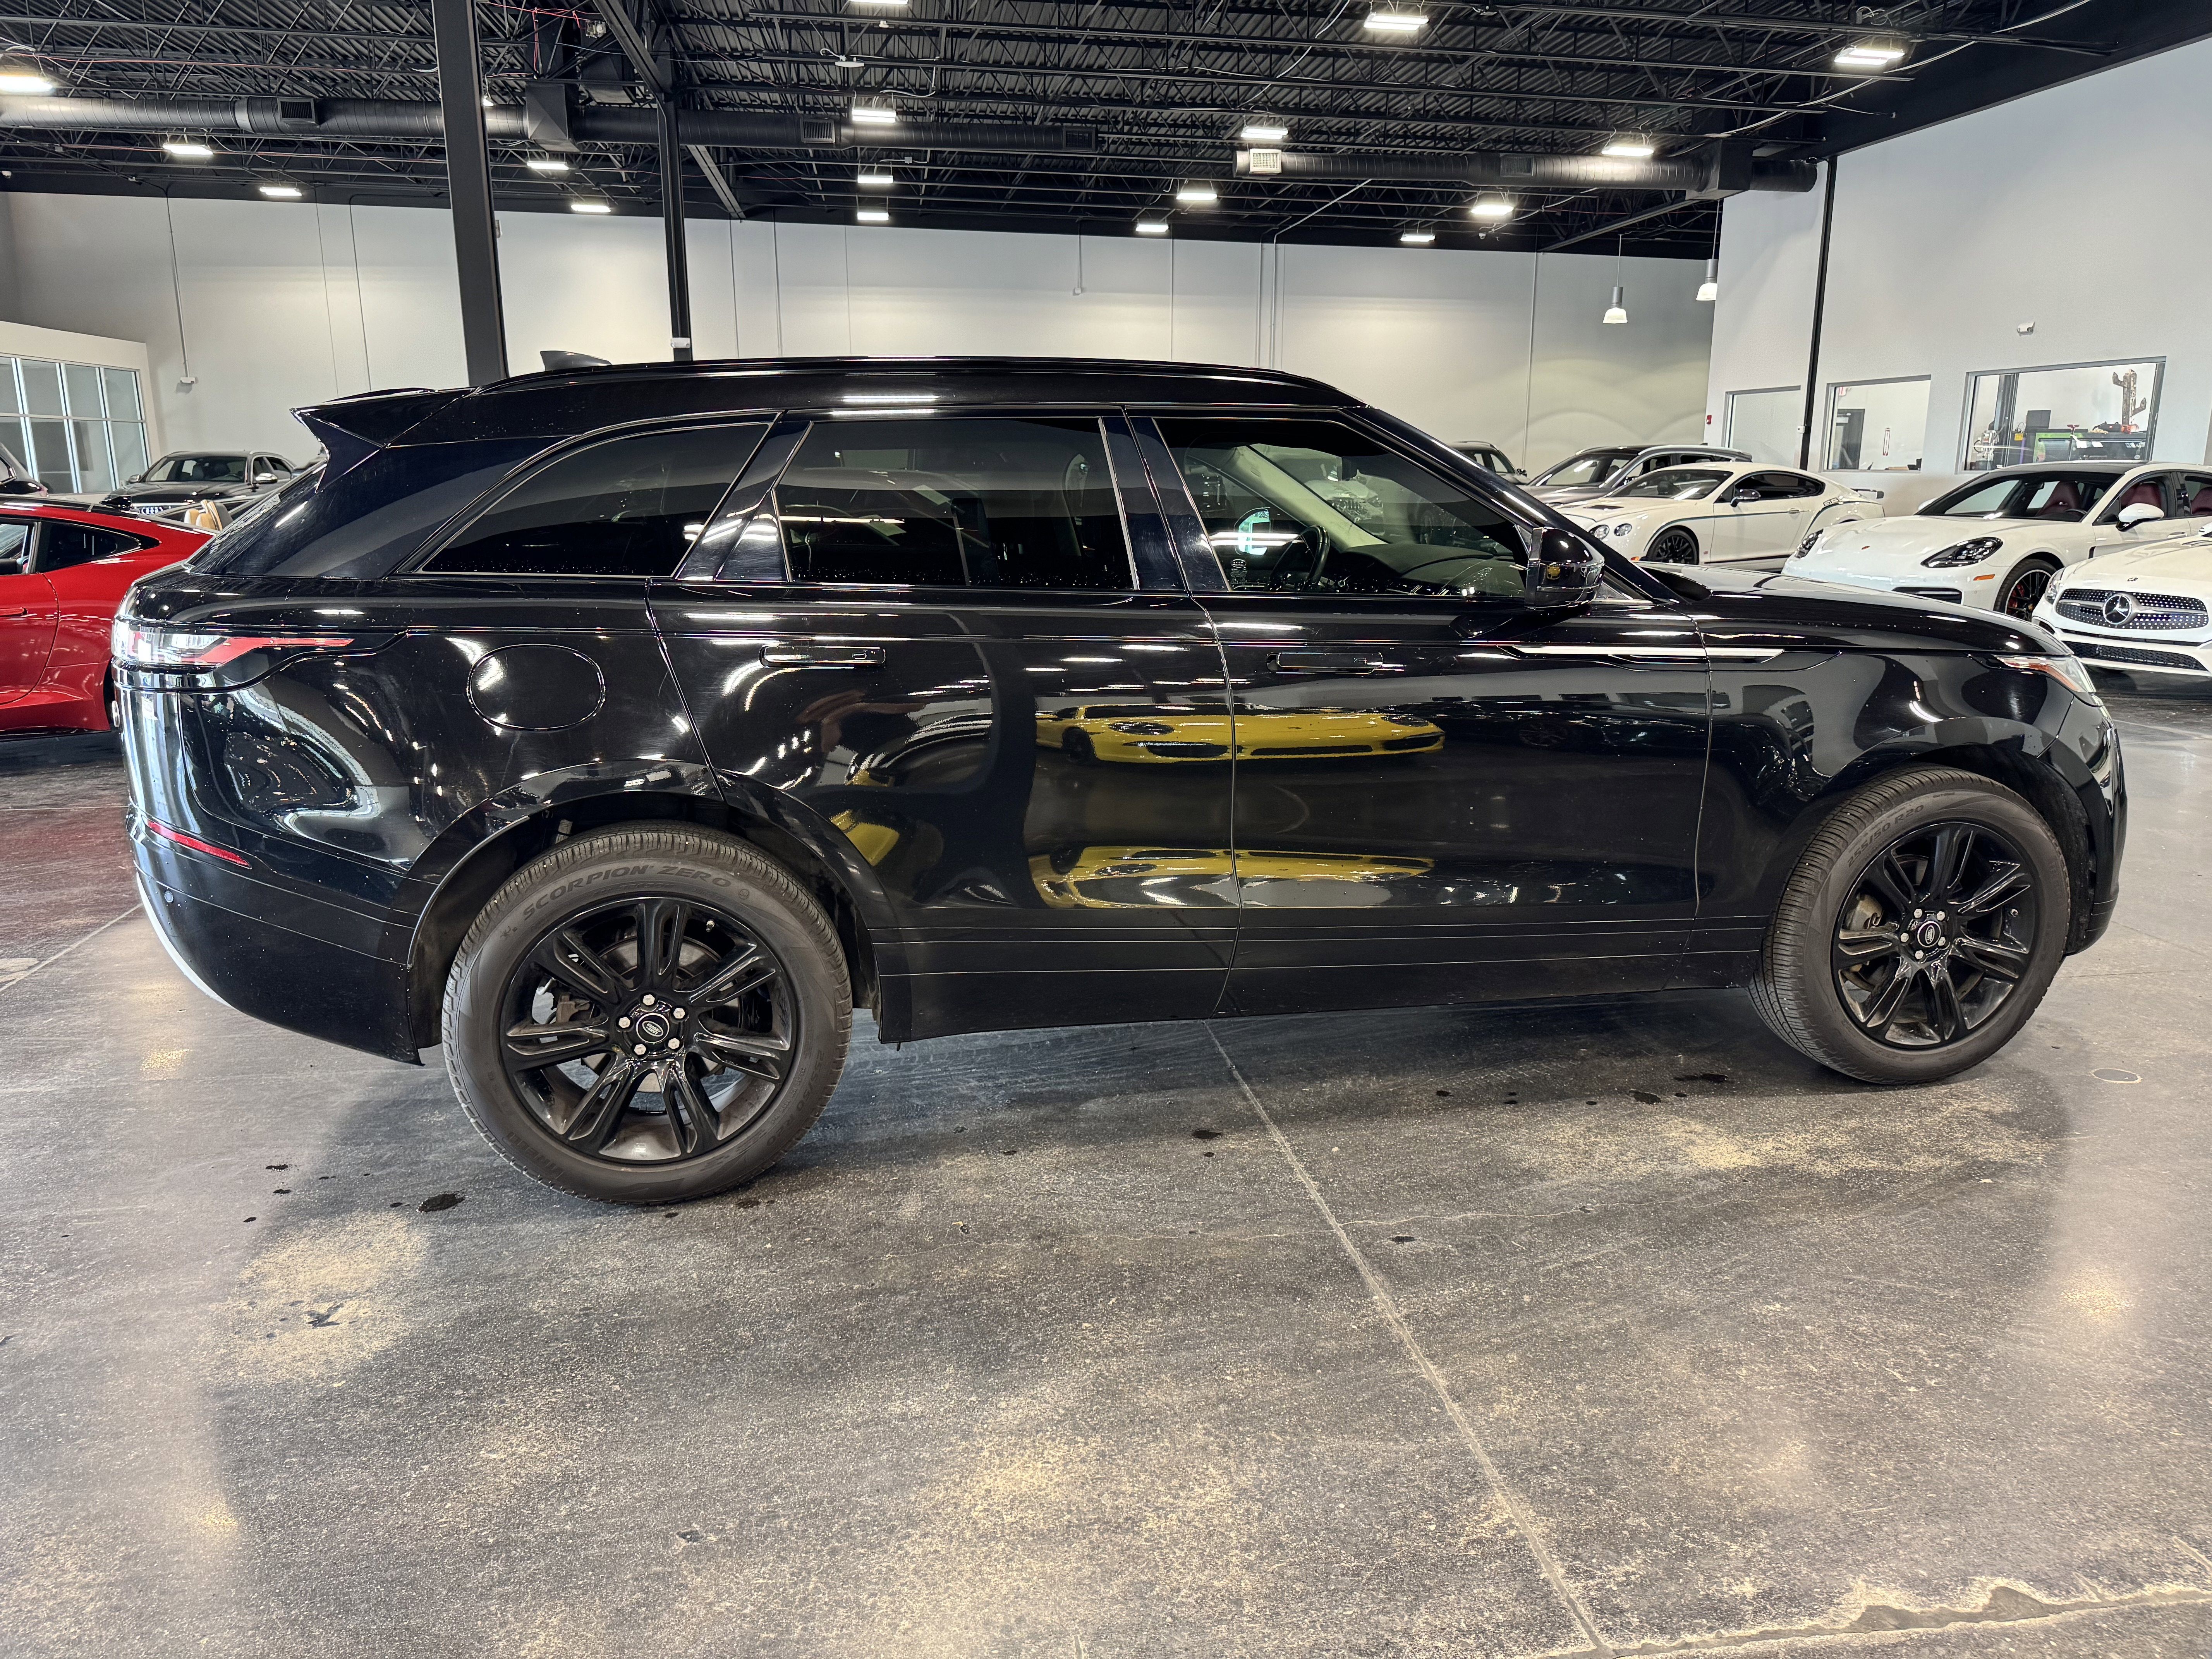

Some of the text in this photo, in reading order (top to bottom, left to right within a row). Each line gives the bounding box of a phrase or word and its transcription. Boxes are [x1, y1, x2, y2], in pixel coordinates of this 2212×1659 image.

[1848, 822, 1891, 867] 255/50
[1894, 805, 1924, 824] R20
[523, 865, 650, 921] SCORPION
[657, 866, 731, 887] ZERO
[647, 1023, 660, 1032] ROVER
